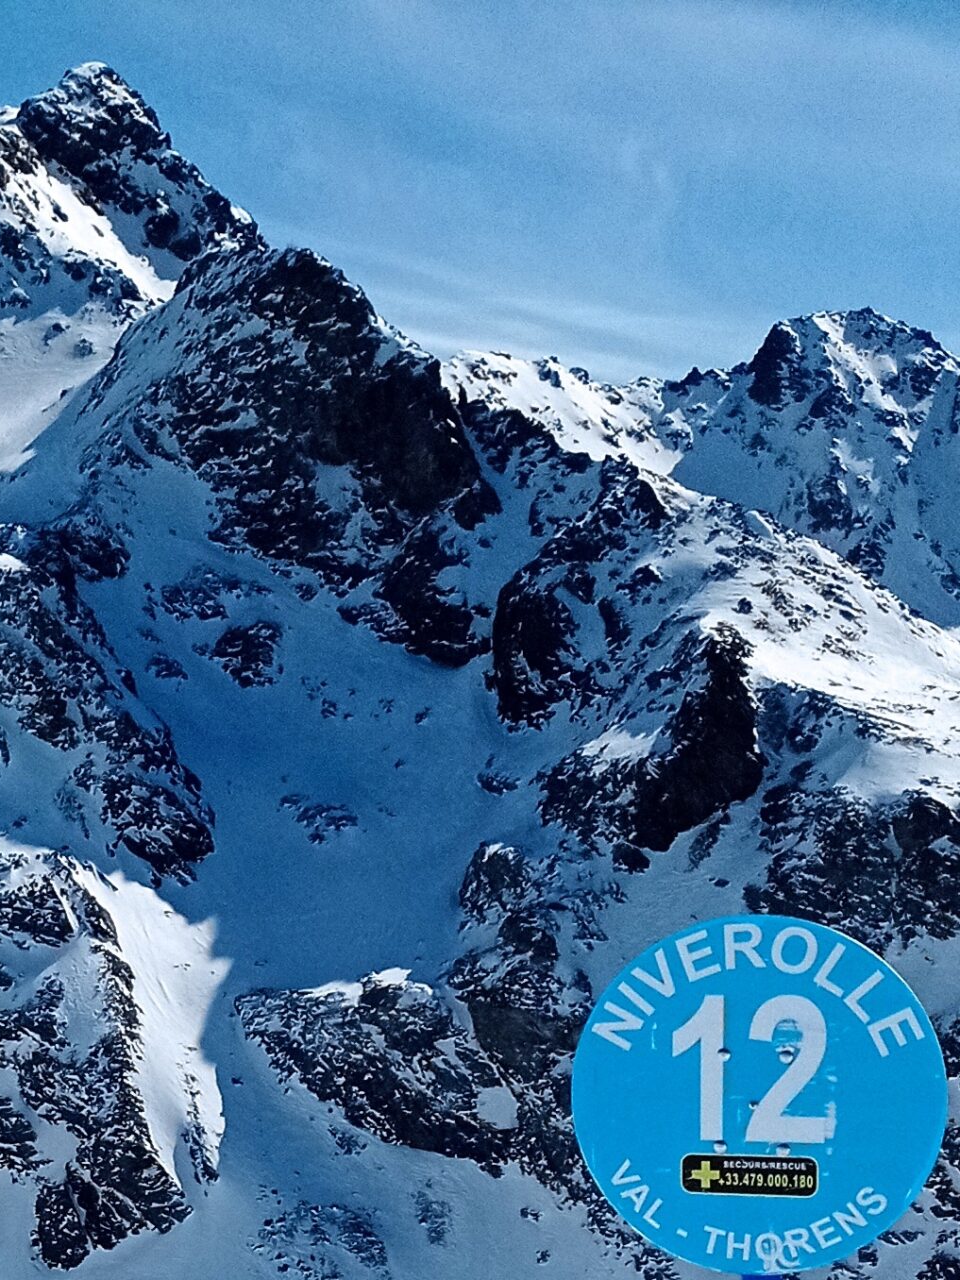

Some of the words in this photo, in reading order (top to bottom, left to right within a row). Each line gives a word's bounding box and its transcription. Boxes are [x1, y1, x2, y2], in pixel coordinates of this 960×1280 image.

[592, 923, 925, 1058] NIVEROLLE
[672, 994, 828, 1144] 12
[611, 1158, 665, 1229] VAL
[703, 1185, 888, 1262] THORENS
